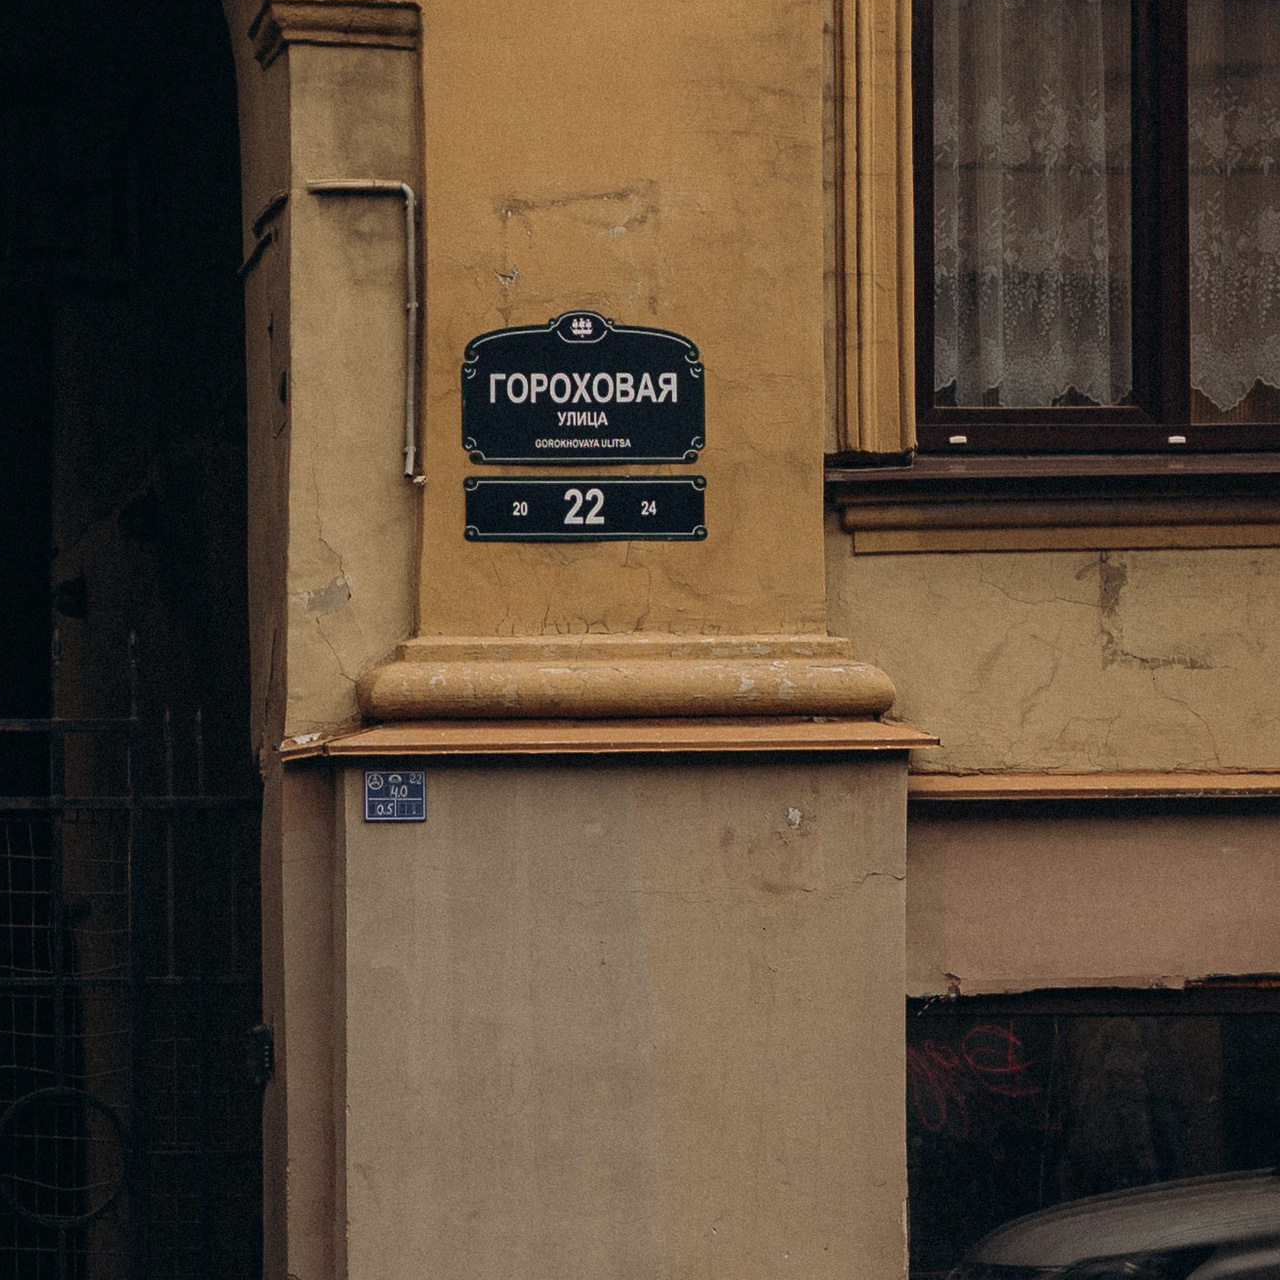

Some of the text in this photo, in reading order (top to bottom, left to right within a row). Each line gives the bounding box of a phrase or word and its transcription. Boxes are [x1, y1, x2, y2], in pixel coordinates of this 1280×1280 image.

[489, 372, 678, 404] ГОРОХОВАЯ
[557, 411, 608, 428] УЛИЦА
[535, 438, 632, 448] GOROKHOVAYA ULITSA
[512, 488, 657, 525] 20 22 24
